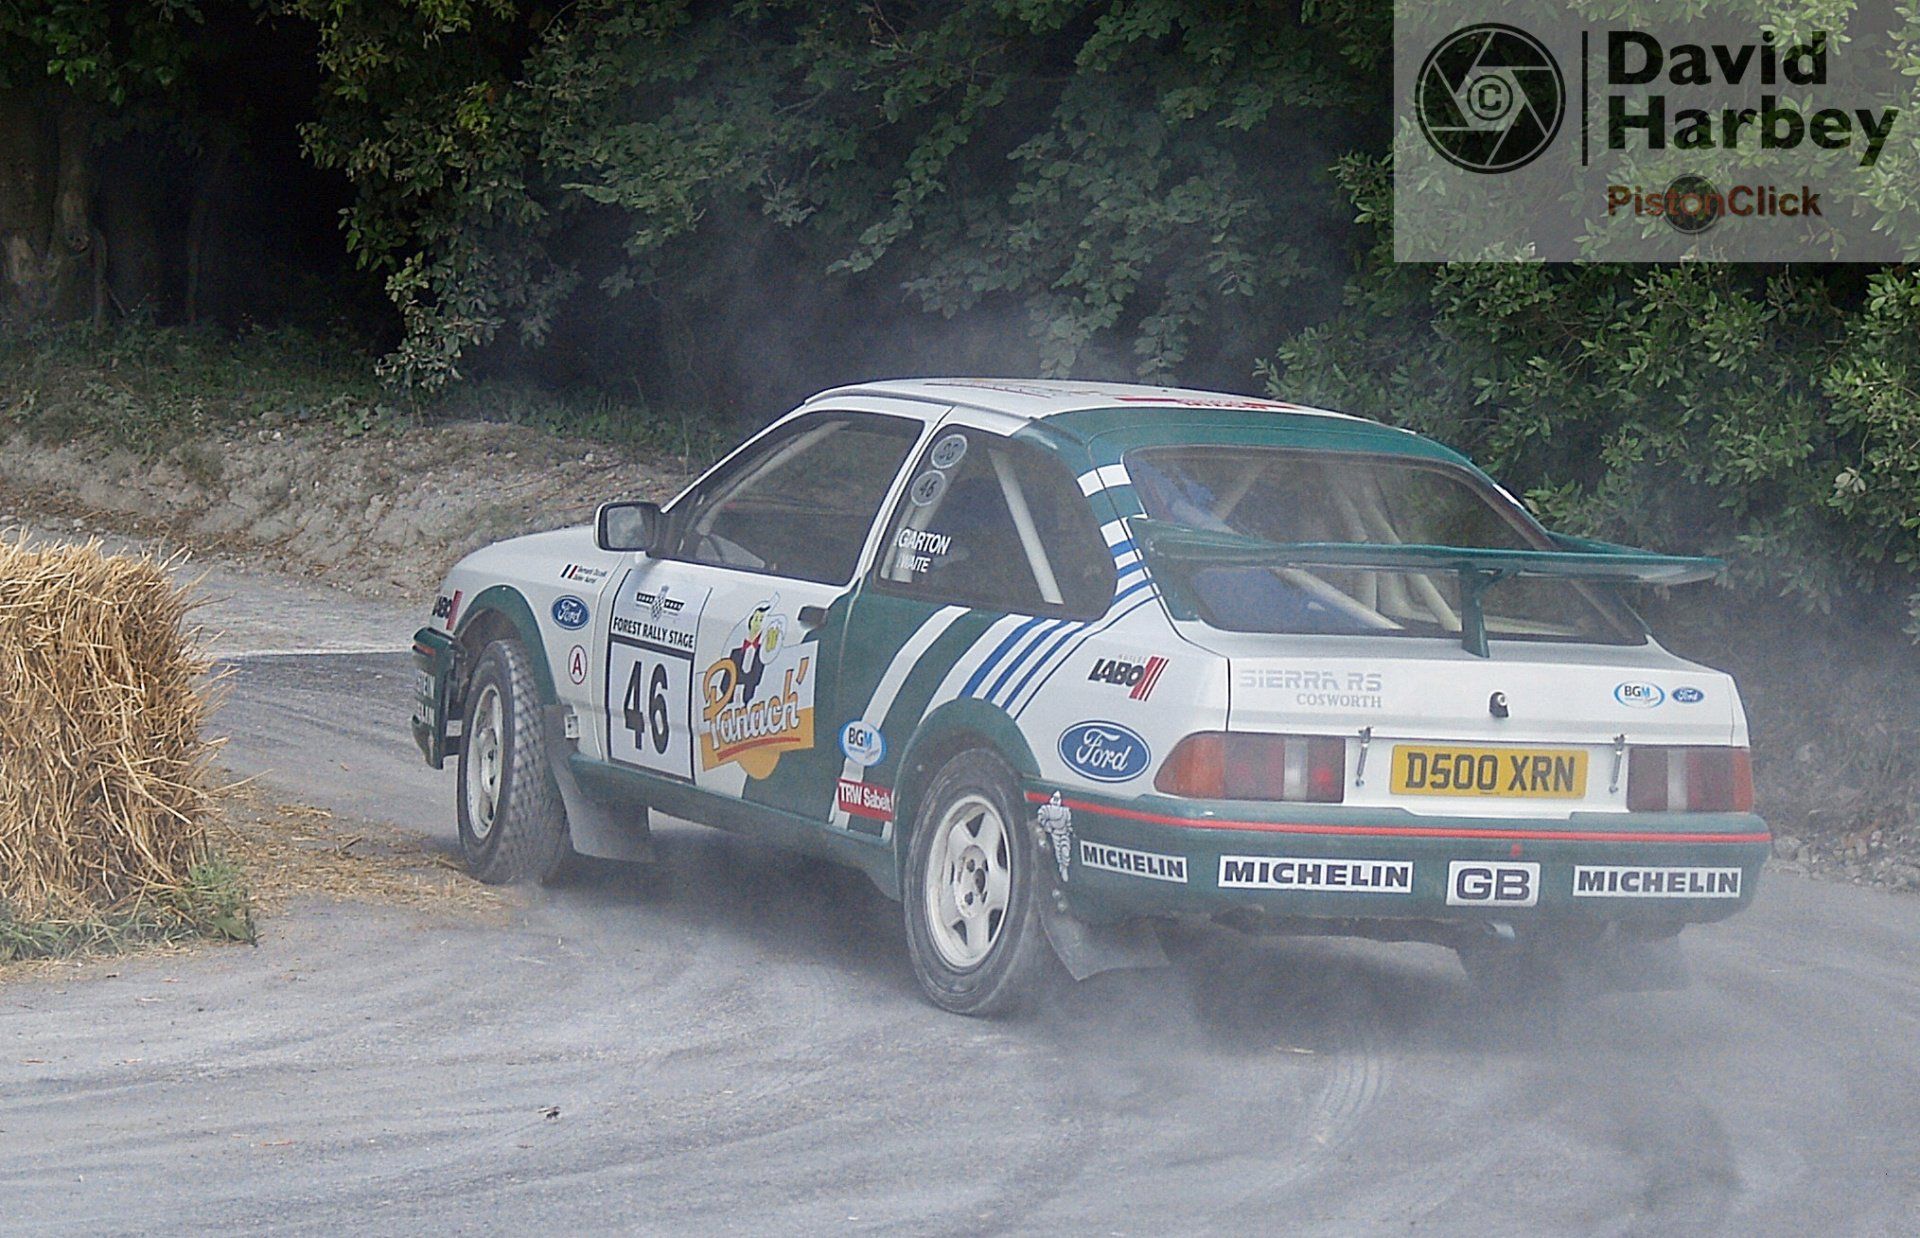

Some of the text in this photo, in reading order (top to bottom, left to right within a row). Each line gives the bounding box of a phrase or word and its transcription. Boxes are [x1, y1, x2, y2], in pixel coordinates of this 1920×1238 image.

[919, 479, 938, 498] 46
[898, 530, 951, 555] GARTON
[557, 599, 583, 623] Ford
[613, 616, 695, 649] FOREST RALLY STAGE
[572, 653, 583, 676] A
[1087, 658, 1145, 688] LABO
[1239, 669, 1382, 692] SIERRA RS
[1624, 685, 1650, 698] BGM
[624, 660, 669, 755] 46
[1296, 692, 1382, 708] COSWORTH
[848, 727, 872, 748] BGM
[1076, 727, 1133, 772] Ford
[1404, 751, 1575, 792] D500 XRN
[840, 781, 863, 806] TRW
[1083, 844, 1184, 879] MICHELIN
[1223, 860, 1409, 888] MICHELIN
[1456, 867, 1531, 902] GB
[1578, 869, 1738, 894] MICHELIN
